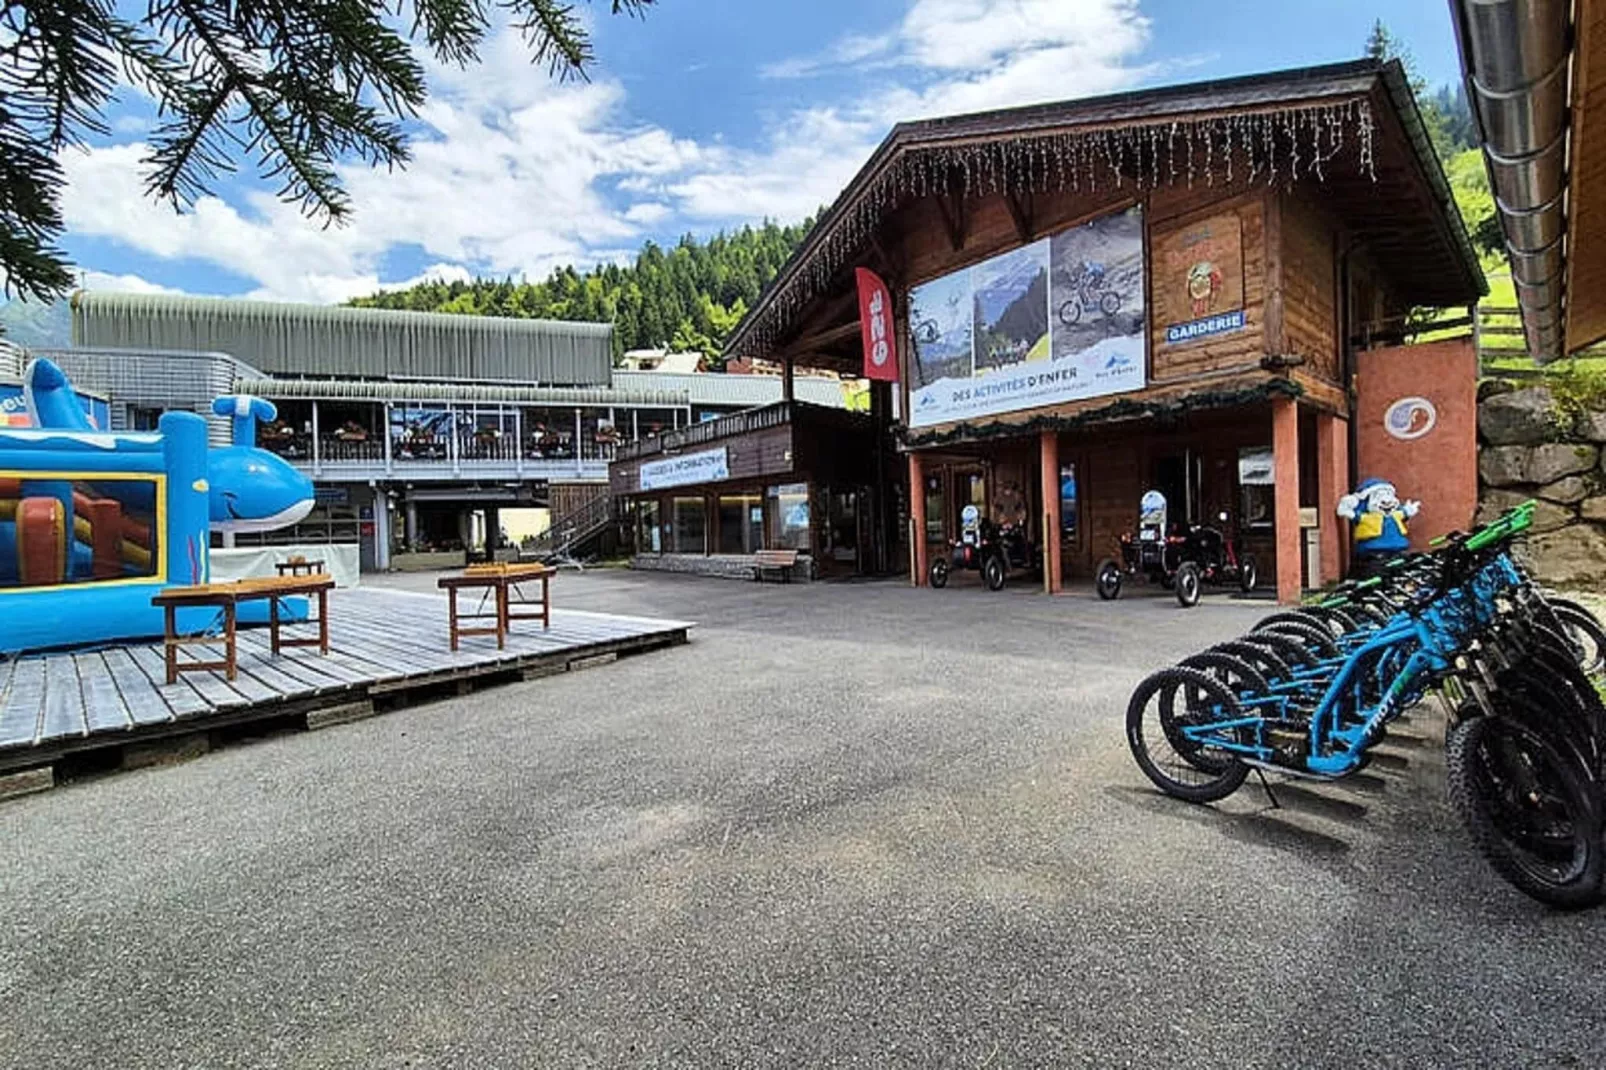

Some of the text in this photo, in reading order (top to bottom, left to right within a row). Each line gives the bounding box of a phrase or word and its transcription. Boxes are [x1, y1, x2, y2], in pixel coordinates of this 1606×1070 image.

[1169, 315, 1241, 339] GARDERIE
[952, 388, 971, 402] DES
[1027, 367, 1077, 387] D'ENFER
